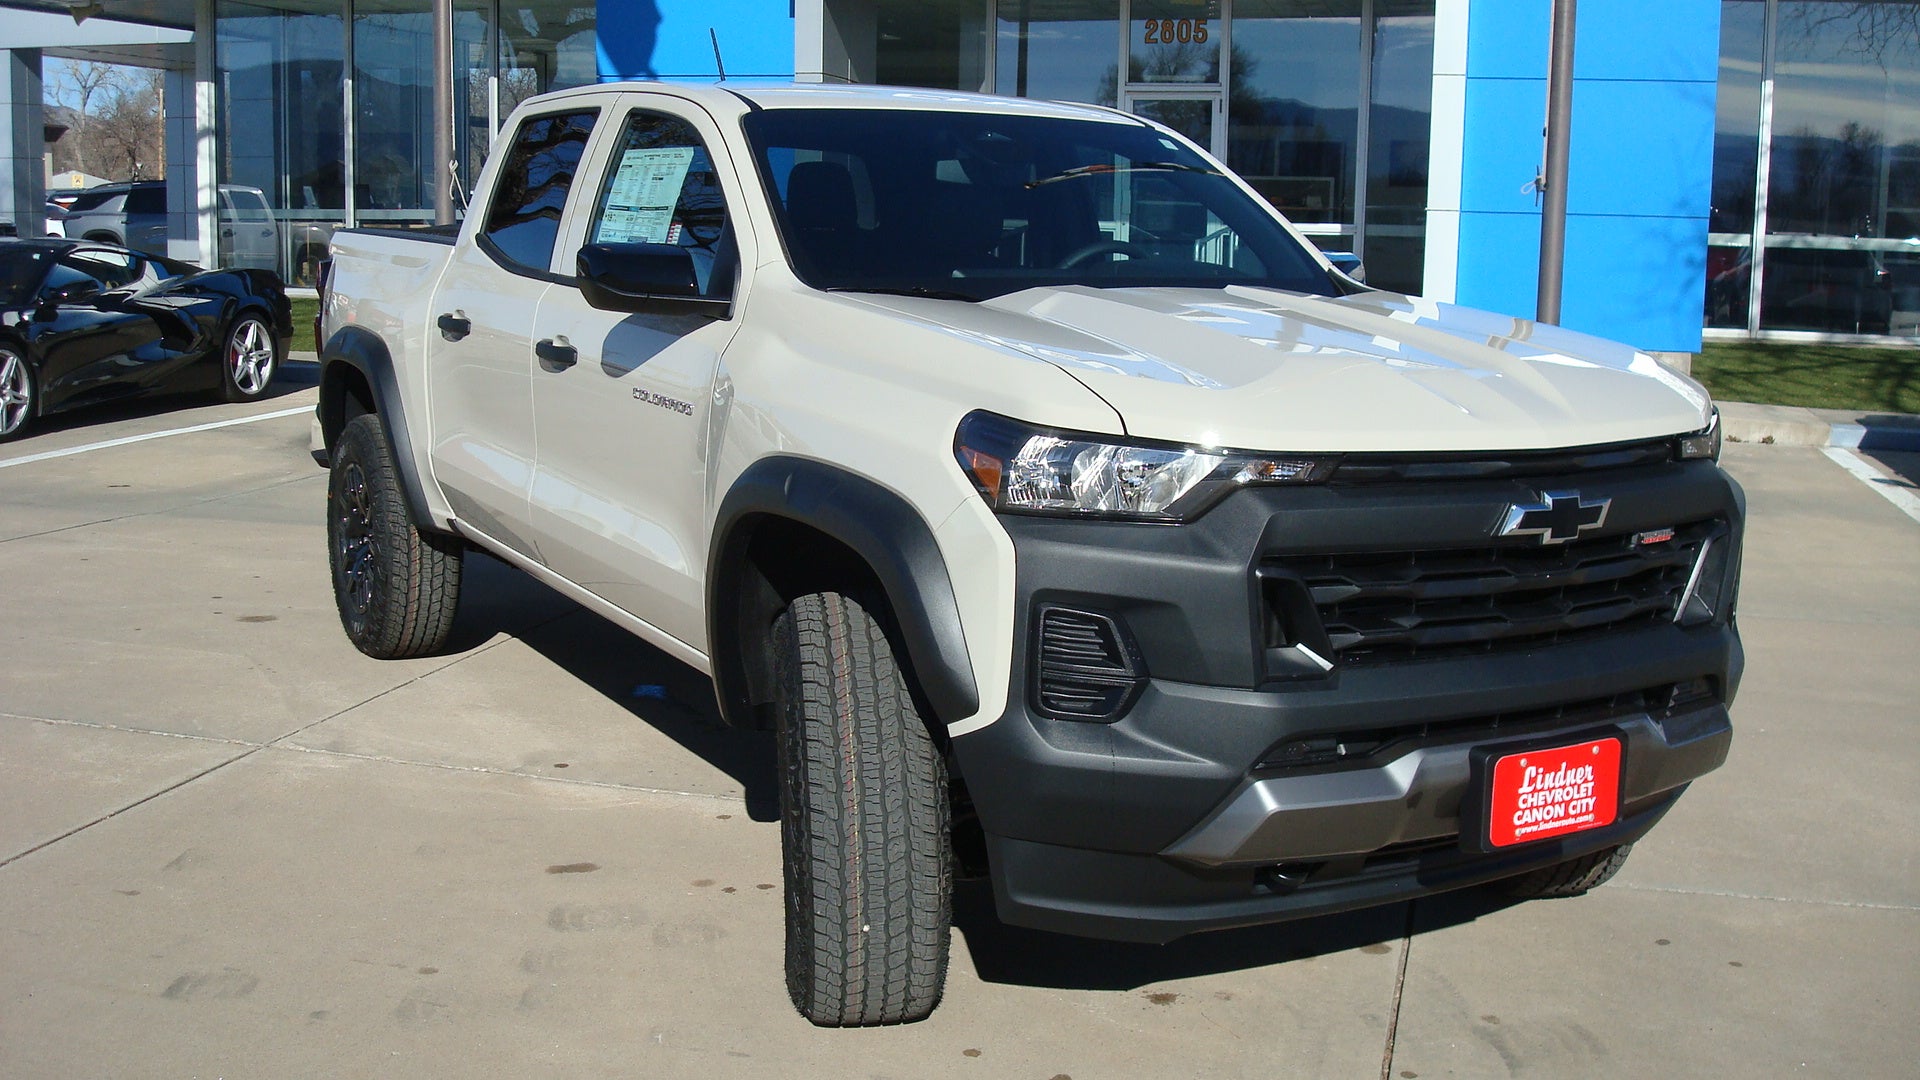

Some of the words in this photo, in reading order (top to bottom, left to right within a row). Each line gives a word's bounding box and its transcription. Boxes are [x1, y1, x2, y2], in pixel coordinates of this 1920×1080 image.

[1145, 19, 1208, 44] 2805
[632, 387, 694, 416] COLORADO
[1518, 761, 1594, 793] Lindner
[1518, 782, 1595, 809] CHEVROLET
[1513, 804, 1565, 826] CANON
[1568, 797, 1597, 815] CITY
